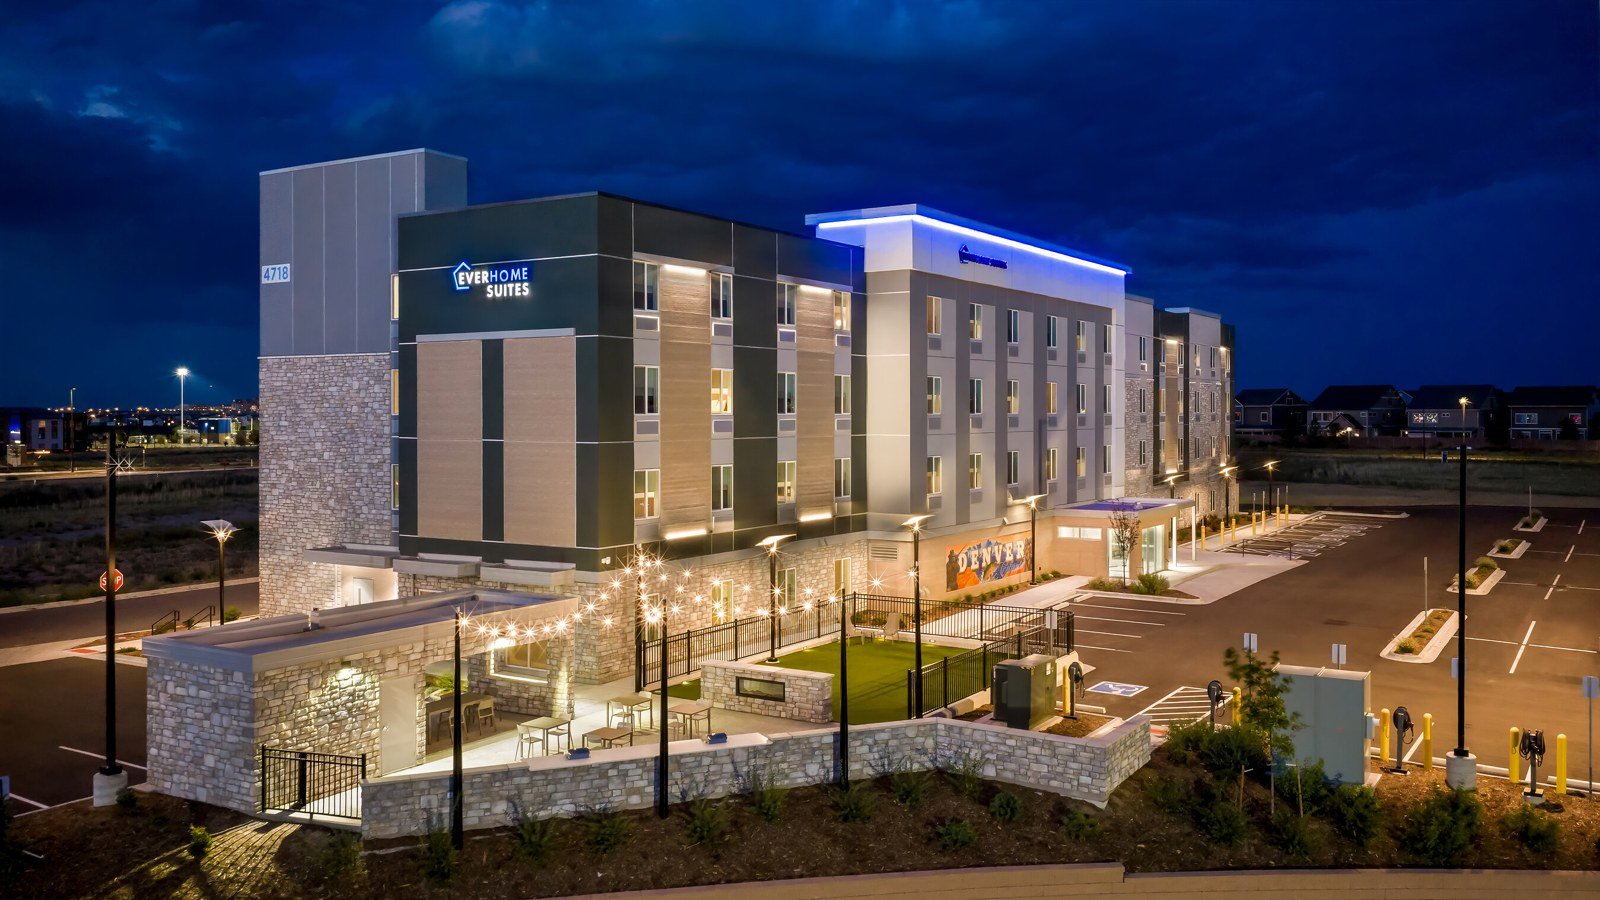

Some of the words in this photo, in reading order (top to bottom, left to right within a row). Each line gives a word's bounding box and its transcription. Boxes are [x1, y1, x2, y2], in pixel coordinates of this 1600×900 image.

[263, 265, 289, 281] 4718
[458, 267, 528, 285] EVERHOME
[486, 282, 529, 298] SUITES
[958, 540, 1025, 573] DENVER
[101, 575, 122, 586] SP
